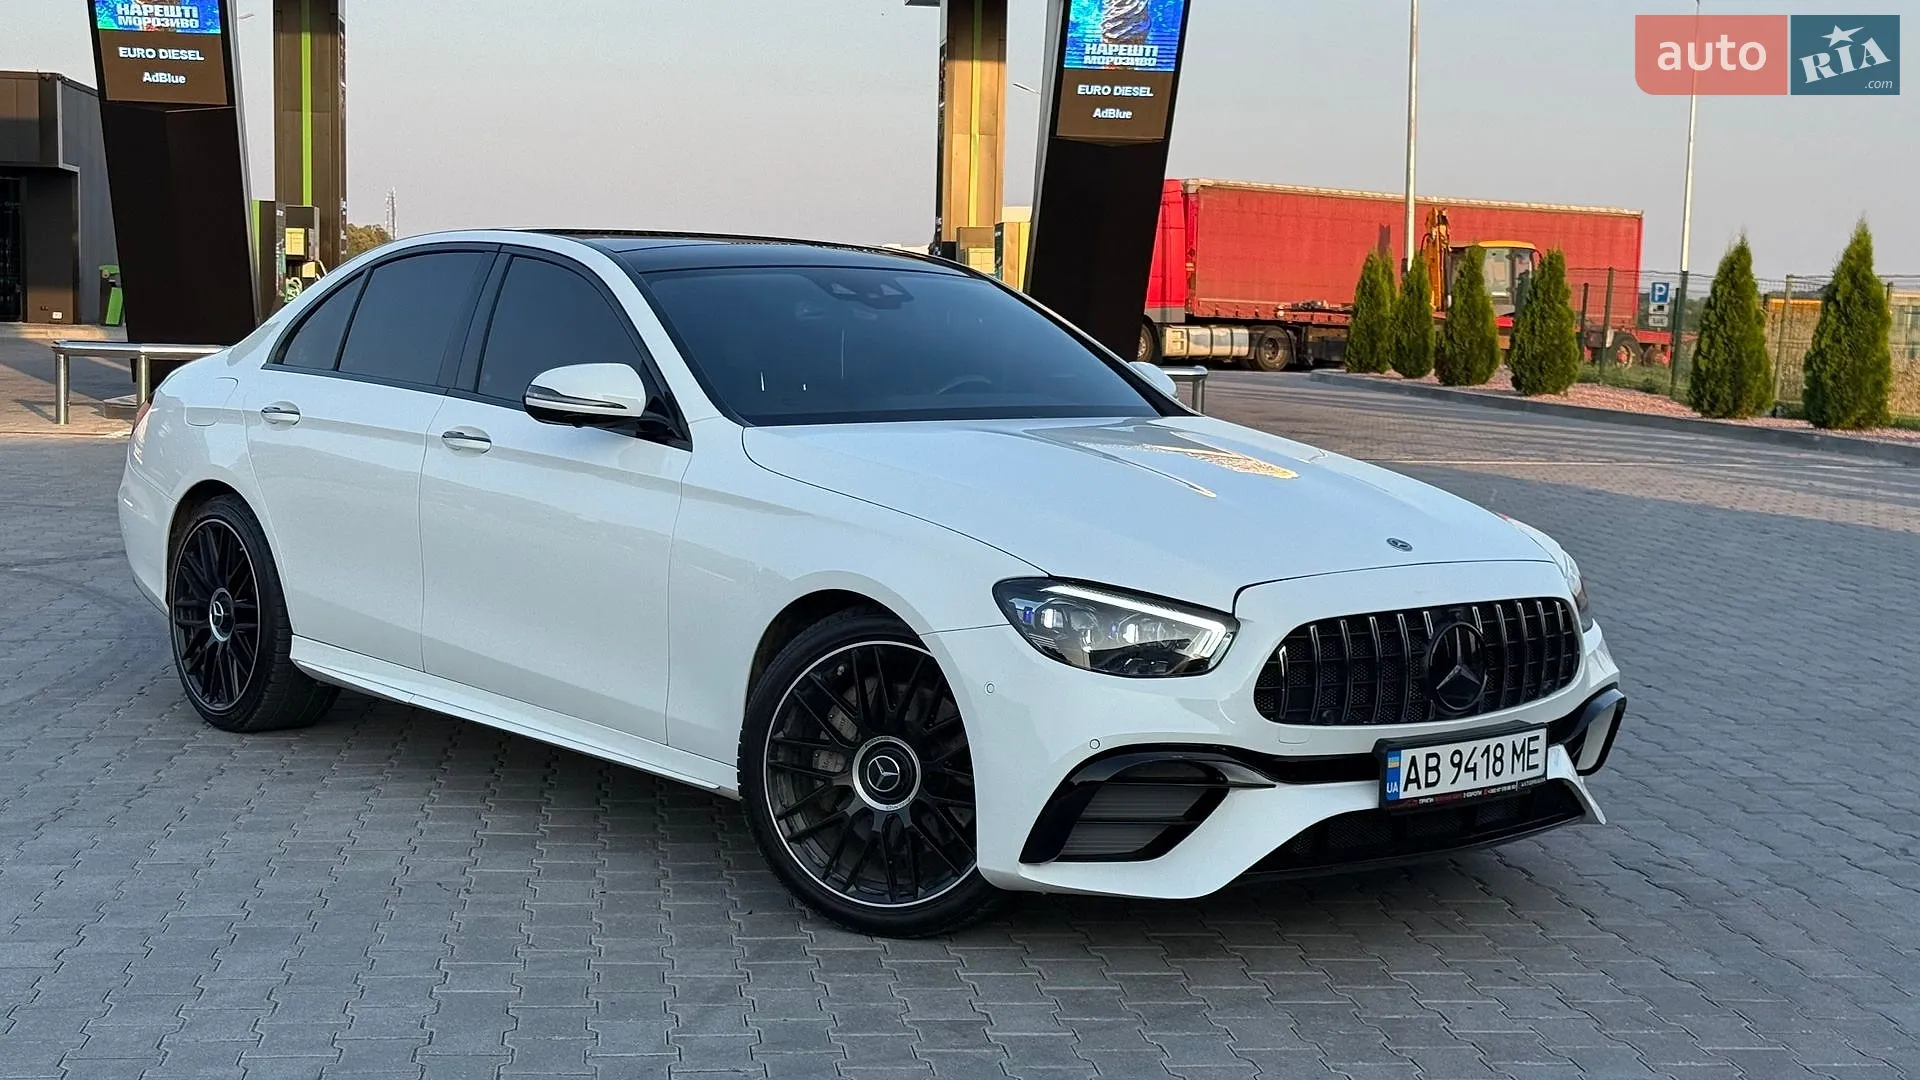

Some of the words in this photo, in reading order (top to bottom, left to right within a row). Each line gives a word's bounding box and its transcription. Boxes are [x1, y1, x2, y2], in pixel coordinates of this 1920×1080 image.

[116, 4, 198, 18] НАРЕШТІ
[117, 15, 199, 28] МОРОЗИВО
[118, 47, 156, 59] EURO
[159, 49, 205, 61] DIESEL
[1084, 43, 1159, 57] НАРЕШТІ
[143, 71, 186, 84] AdBlue
[1077, 84, 1111, 96] EURO
[1113, 86, 1154, 97] DIESEL
[1093, 108, 1133, 119] AdBlue
[1655, 283, 1667, 302] P
[1403, 751, 1441, 792] AB
[1450, 742, 1505, 785] 9418
[1511, 735, 1540, 774] ME
[1386, 781, 1399, 794] UA
